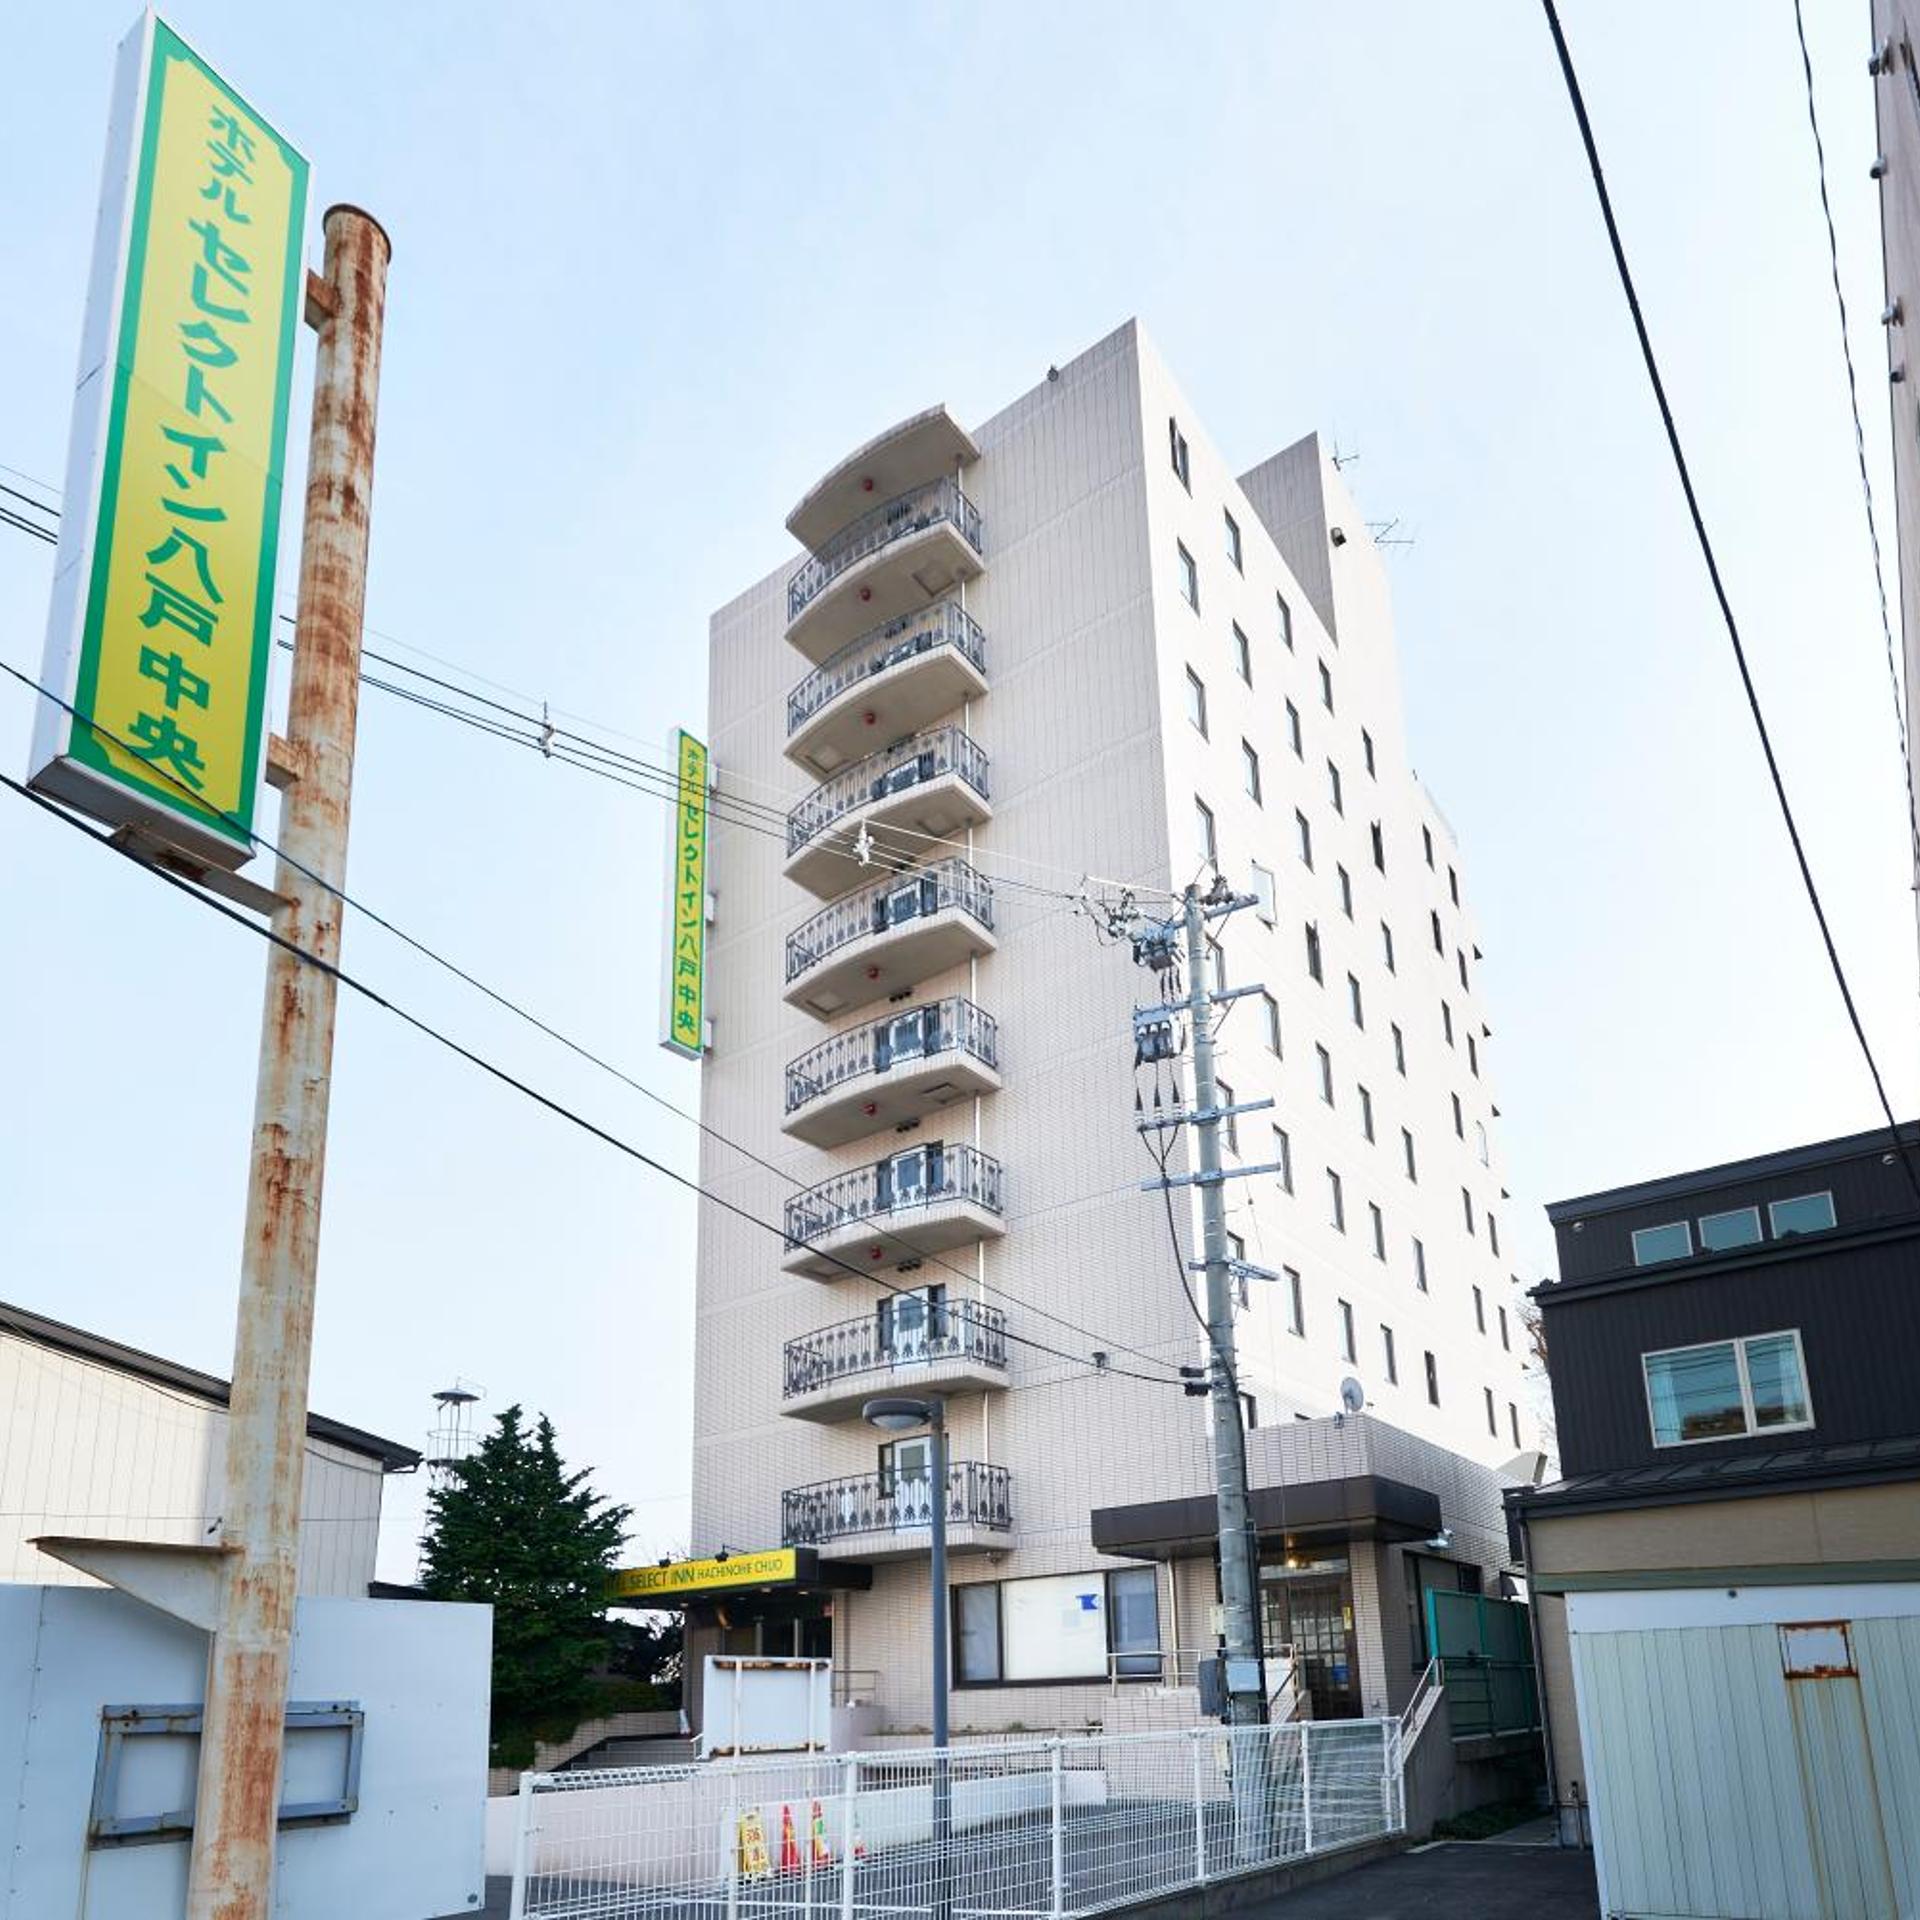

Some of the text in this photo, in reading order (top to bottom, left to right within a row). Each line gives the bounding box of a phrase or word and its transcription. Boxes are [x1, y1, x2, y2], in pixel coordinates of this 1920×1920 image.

[630, 1571, 668, 1589] SELECT
[671, 1567, 695, 1585] INN
[697, 1563, 752, 1580] HACHINOHE
[754, 1559, 783, 1574] CHUO
